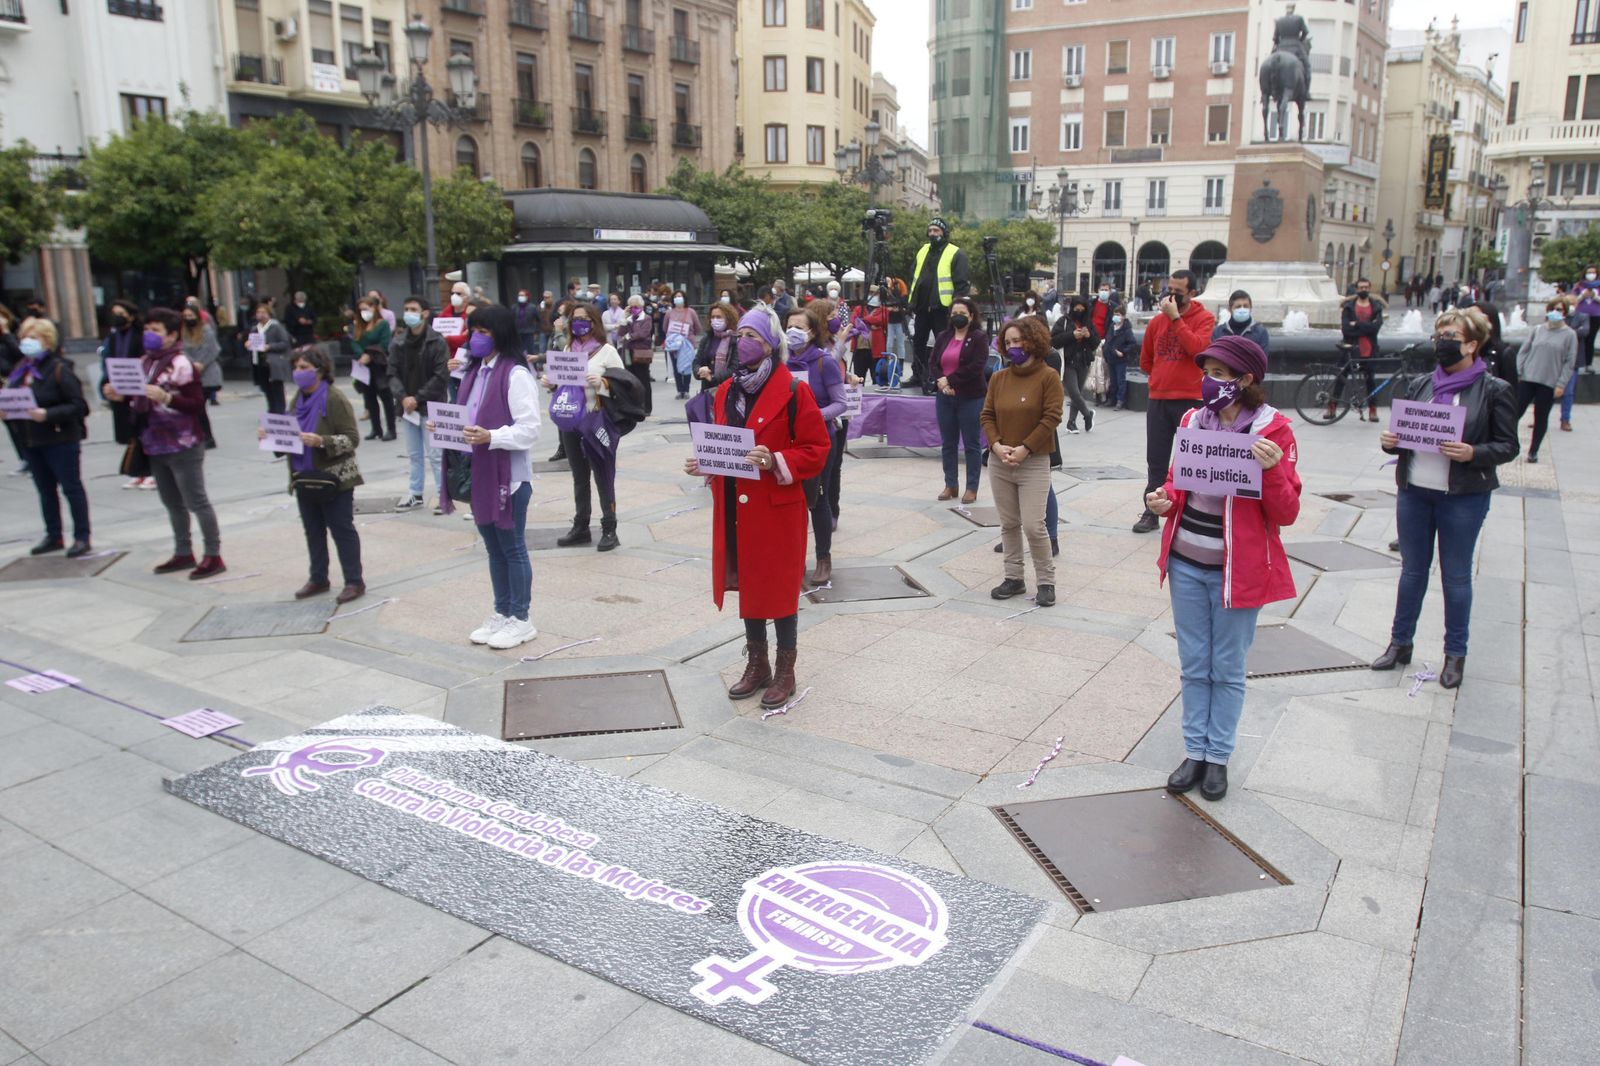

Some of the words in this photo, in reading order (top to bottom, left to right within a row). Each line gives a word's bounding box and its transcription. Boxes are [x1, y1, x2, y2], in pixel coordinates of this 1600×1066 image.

[1405, 407, 1451, 420] REIVINDICAMOS
[1397, 419, 1420, 430] EMPLEO
[1420, 423, 1428, 431] DE
[1429, 424, 1456, 436] CALIDAD,
[704, 431, 733, 442] DENUNCIAMOS
[733, 434, 742, 443] QUE
[1397, 433, 1422, 443] TRABAJO
[1422, 437, 1435, 445] NOS
[697, 445, 702, 453] LA
[703, 445, 716, 455] CARGA
[717, 447, 722, 455] DE
[723, 447, 732, 456] LOS
[1180, 439, 1189, 453] Si
[1191, 443, 1203, 454] es
[699, 458, 712, 467] RECAE
[712, 460, 726, 469] SOBRE
[726, 461, 734, 470] LAS
[734, 462, 754, 472] MUJERES
[1180, 466, 1193, 477] no
[1196, 468, 1207, 479] es
[1209, 467, 1251, 484] justicia.
[387, 767, 487, 808] Plataforma
[486, 802, 596, 847] Cordobesa
[358, 779, 424, 811] Contra
[421, 801, 446, 820] la
[446, 808, 544, 856] Violencia
[542, 848, 562, 863] a
[561, 851, 602, 875] las
[599, 866, 708, 911] Mujeres
[757, 873, 932, 958] EMERGENCIA
[765, 909, 855, 956] FEMINISTA
